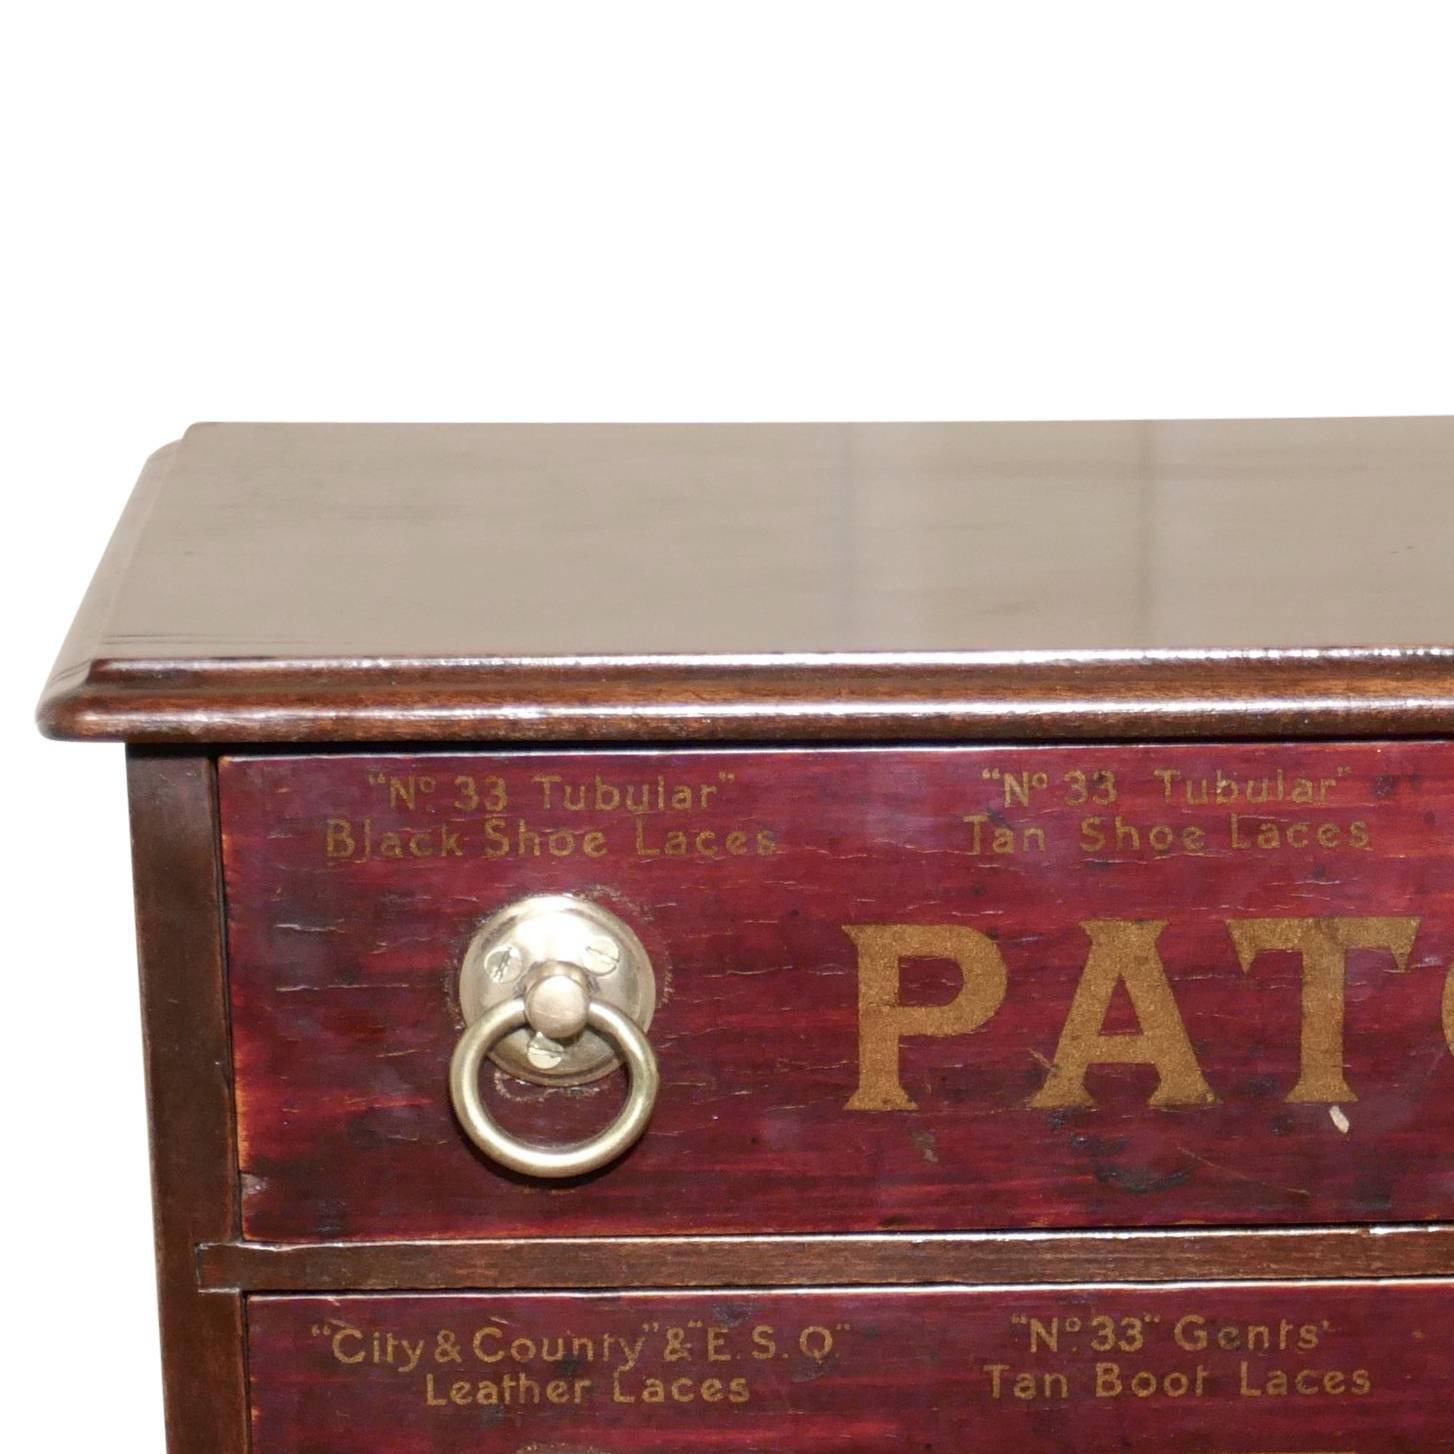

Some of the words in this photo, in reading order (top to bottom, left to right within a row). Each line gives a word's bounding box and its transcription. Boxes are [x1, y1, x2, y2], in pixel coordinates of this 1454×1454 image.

[454, 775, 509, 812] 33
[532, 769, 735, 812] Tubular"
[1064, 769, 1118, 806] 33
[1153, 765, 1351, 805] Tubular"
[325, 817, 463, 859] Black
[485, 818, 607, 858] Shoe
[636, 818, 777, 857] Laces
[962, 813, 1046, 855] Tan
[1080, 814, 1206, 852] Shoe
[1231, 812, 1370, 850] Laces
[311, 1324, 423, 1373] "City
[434, 1329, 462, 1364] &
[472, 1322, 659, 1374] County"
[663, 1326, 692, 1362] &
[1090, 1313, 1161, 1353] 33"
[1173, 1313, 1331, 1354] Gents'
[426, 1373, 591, 1406] Leather
[613, 1370, 750, 1404] Laces
[983, 1364, 1069, 1399] Tan
[1095, 1361, 1209, 1398] Boot
[1240, 1360, 1372, 1397] Laces
